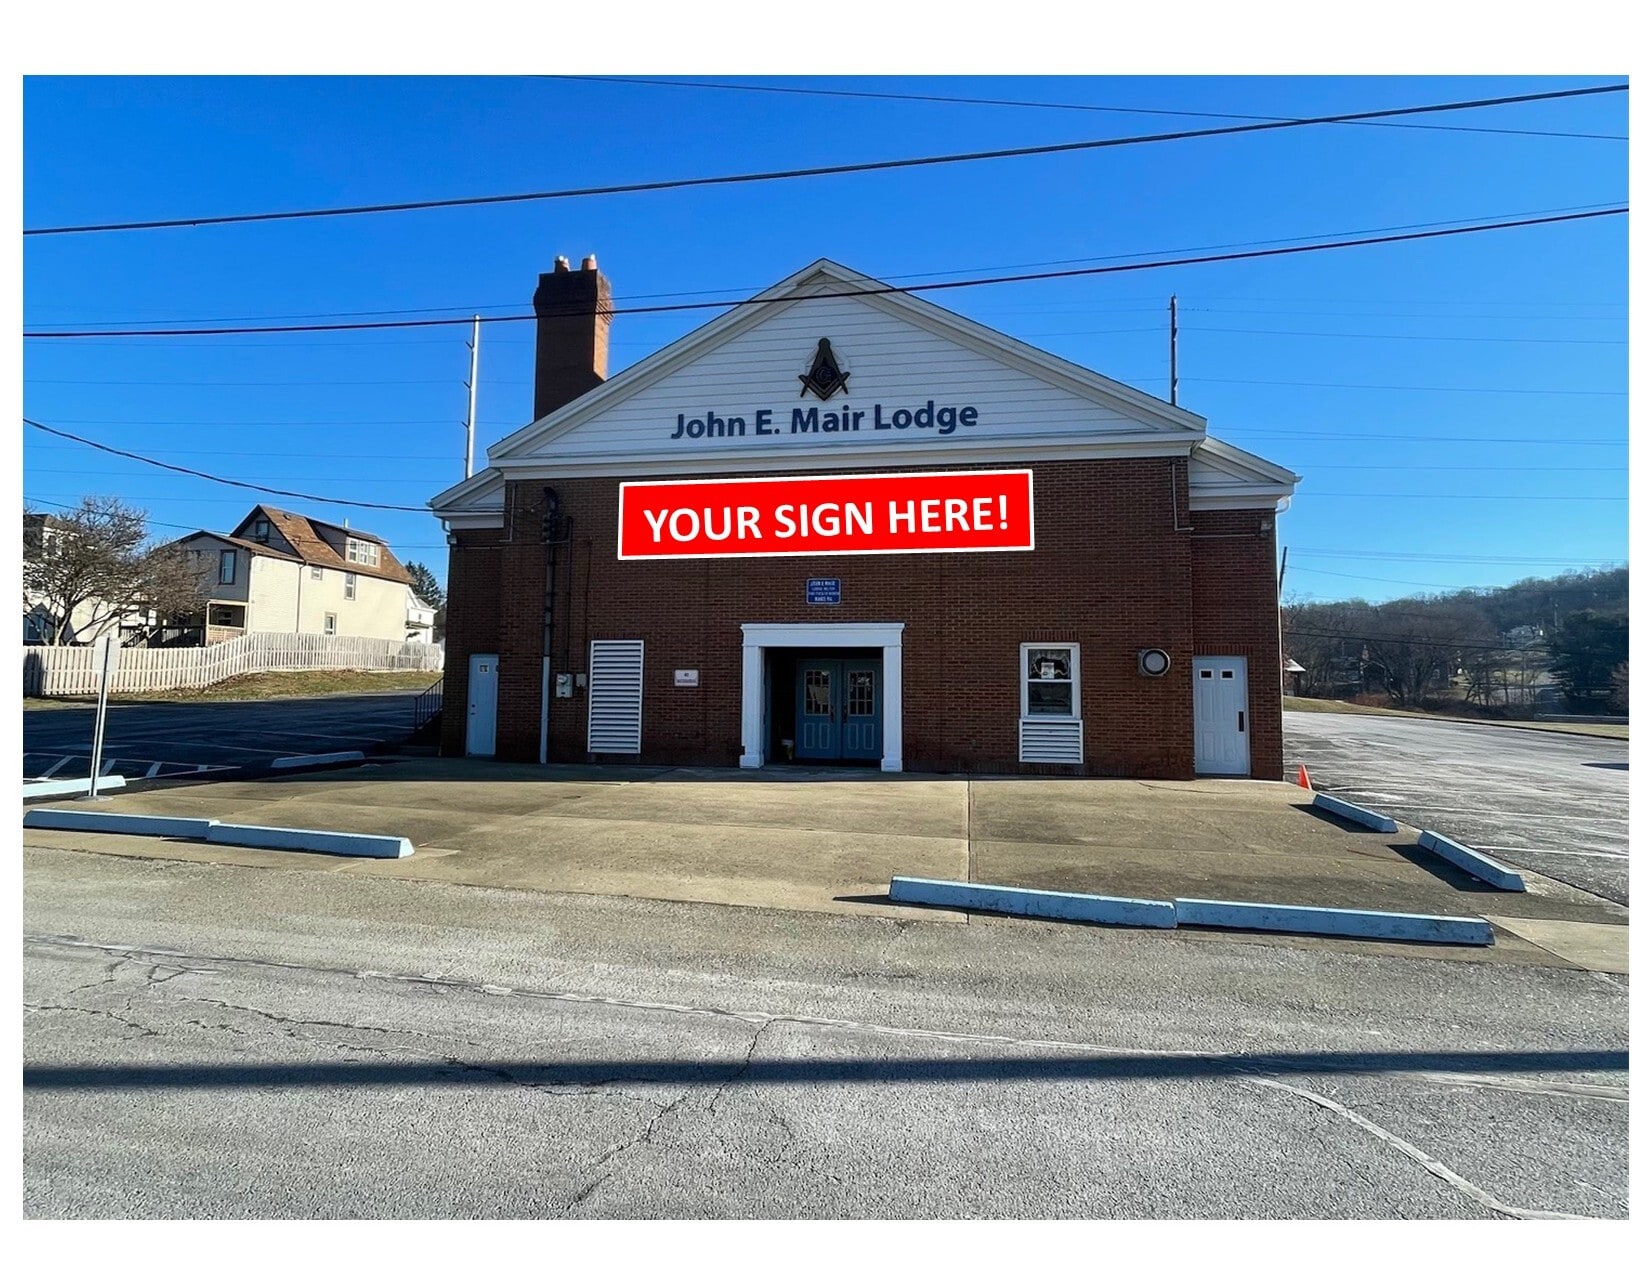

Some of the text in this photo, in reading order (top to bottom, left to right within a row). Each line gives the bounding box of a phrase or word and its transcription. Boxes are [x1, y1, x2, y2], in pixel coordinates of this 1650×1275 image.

[670, 399, 979, 440] John E. Mair Lodge
